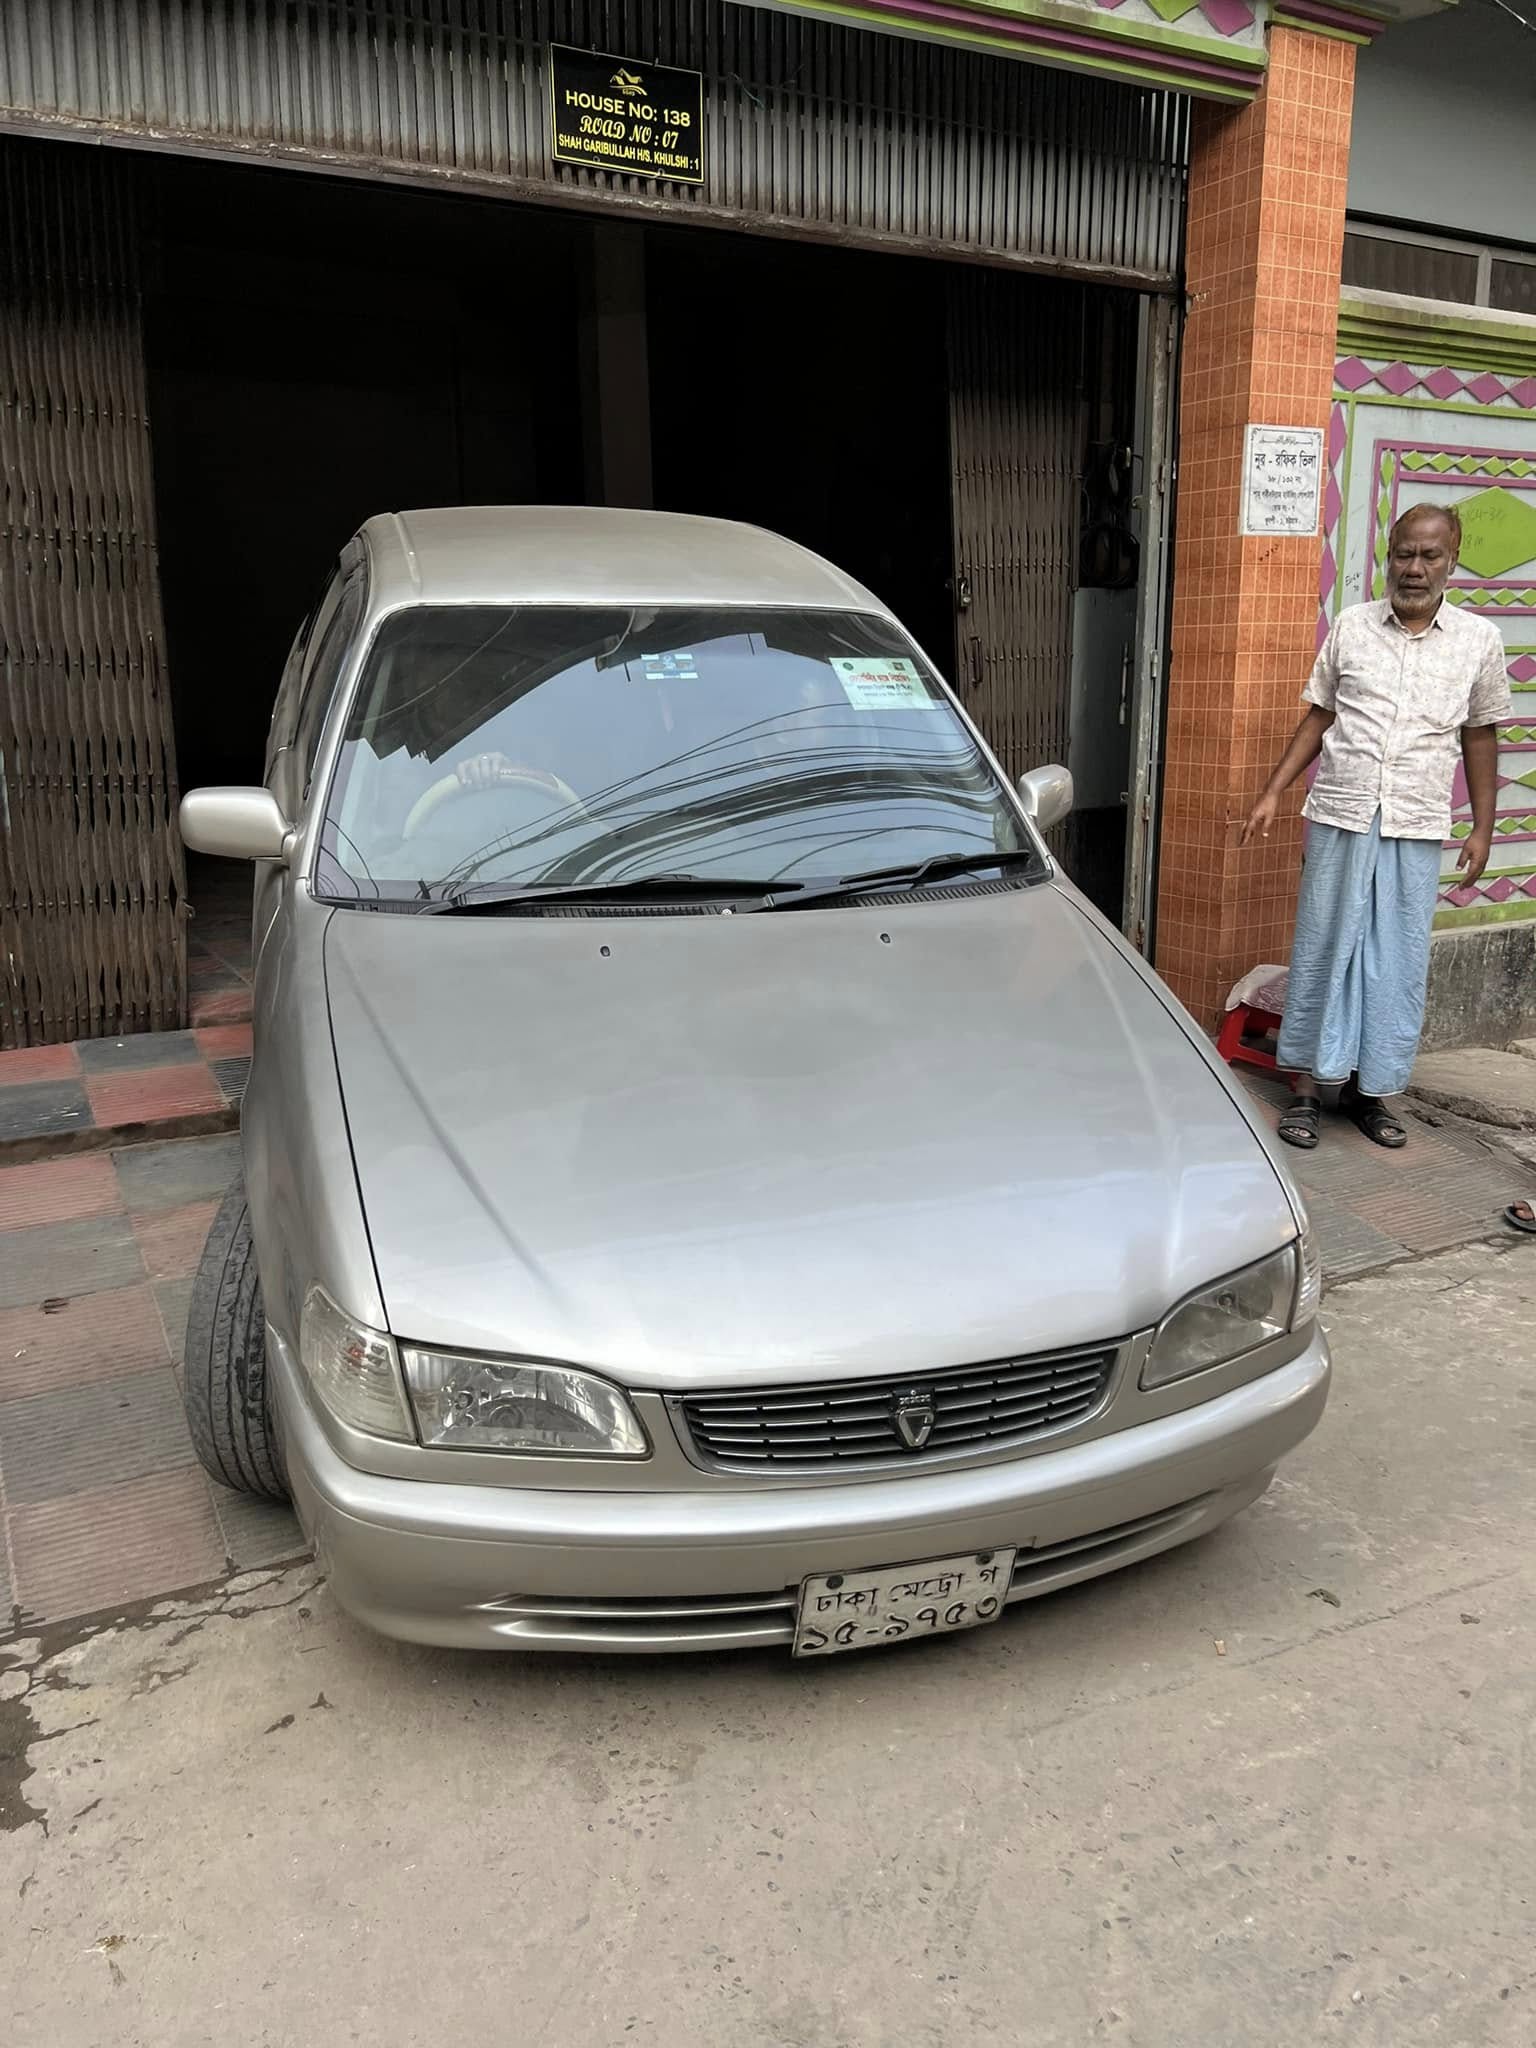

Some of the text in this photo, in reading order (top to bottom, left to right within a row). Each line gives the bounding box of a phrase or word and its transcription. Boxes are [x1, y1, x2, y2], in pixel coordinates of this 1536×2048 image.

[565, 90, 691, 127] HOUSE NO: 138
[579, 115, 626, 140] ROAD
[558, 134, 582, 150] SHAH
[583, 138, 636, 160] GARIBULLAH
[653, 151, 689, 169] KHULSHI
[815, 1587, 878, 1614] ঢাকা
